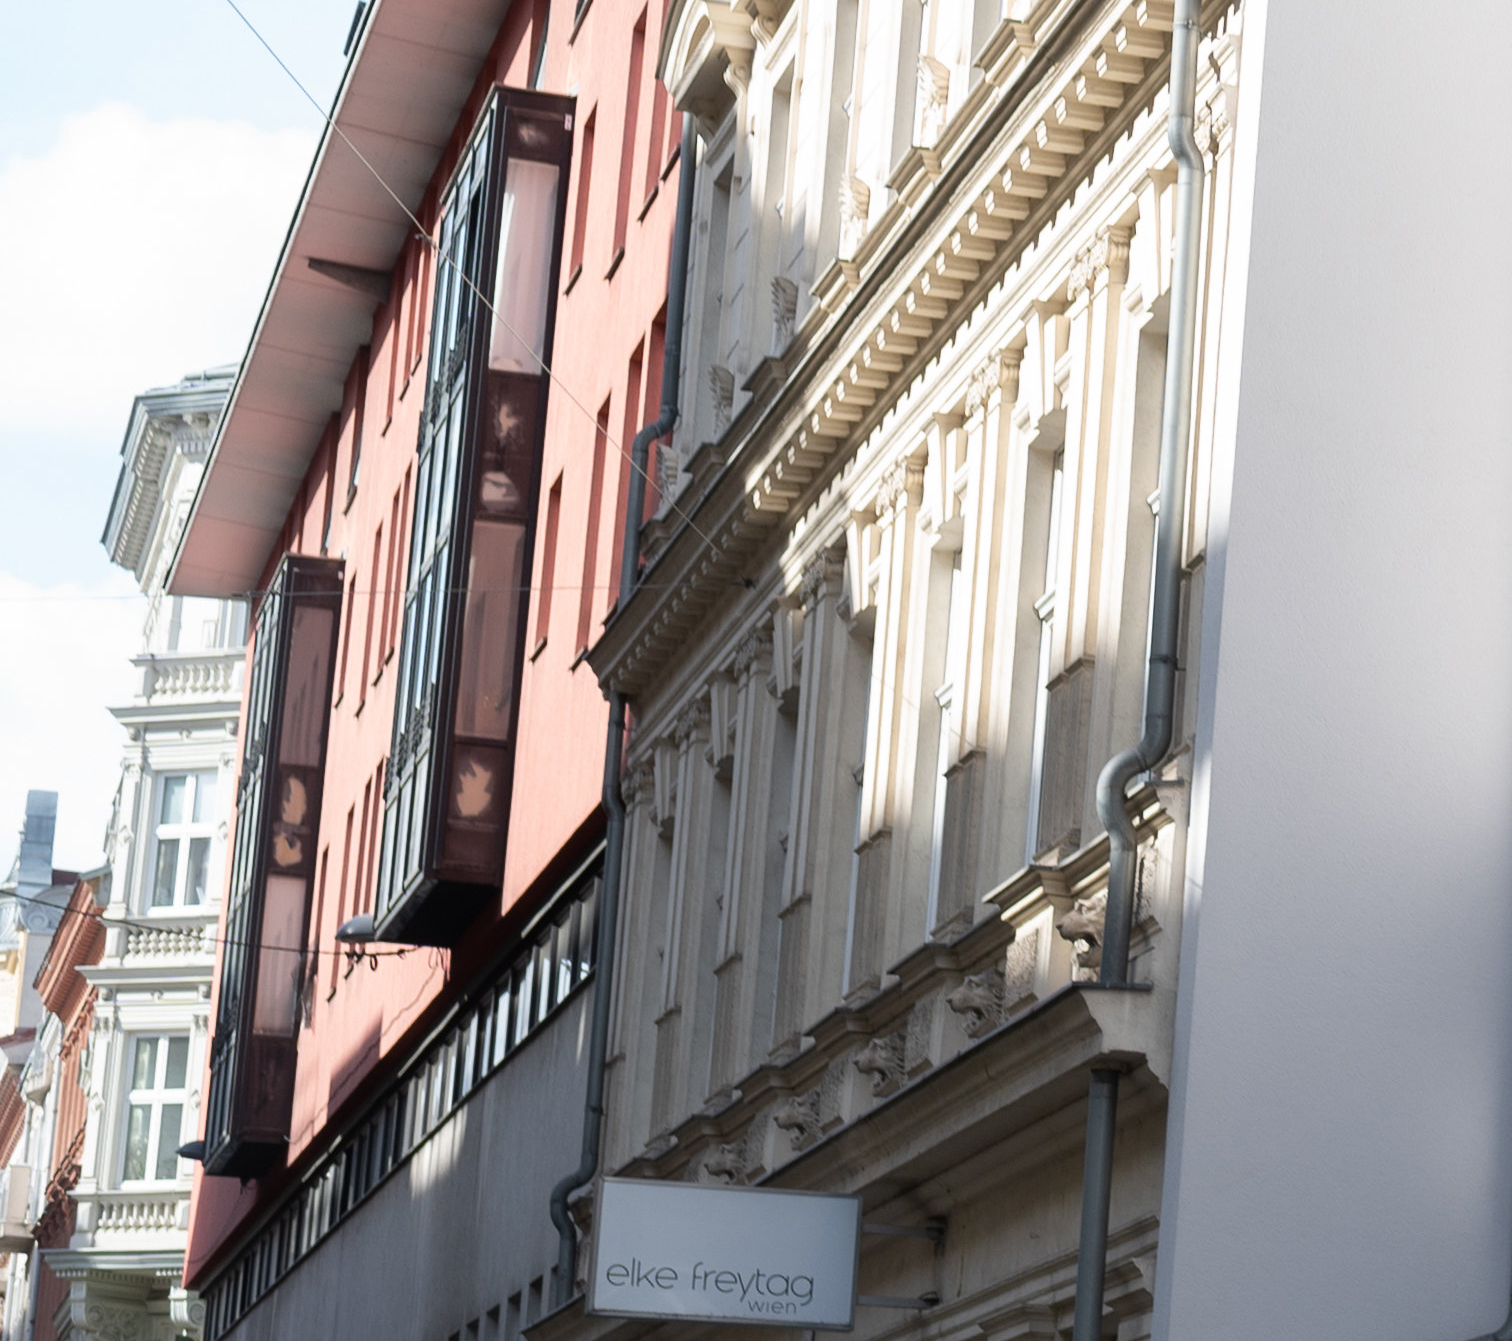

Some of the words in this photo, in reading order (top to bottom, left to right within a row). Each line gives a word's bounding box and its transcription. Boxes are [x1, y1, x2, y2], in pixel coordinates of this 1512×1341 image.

[606, 1257, 678, 1290] elke
[691, 1261, 814, 1307] freytag
[747, 1298, 797, 1315] wien
